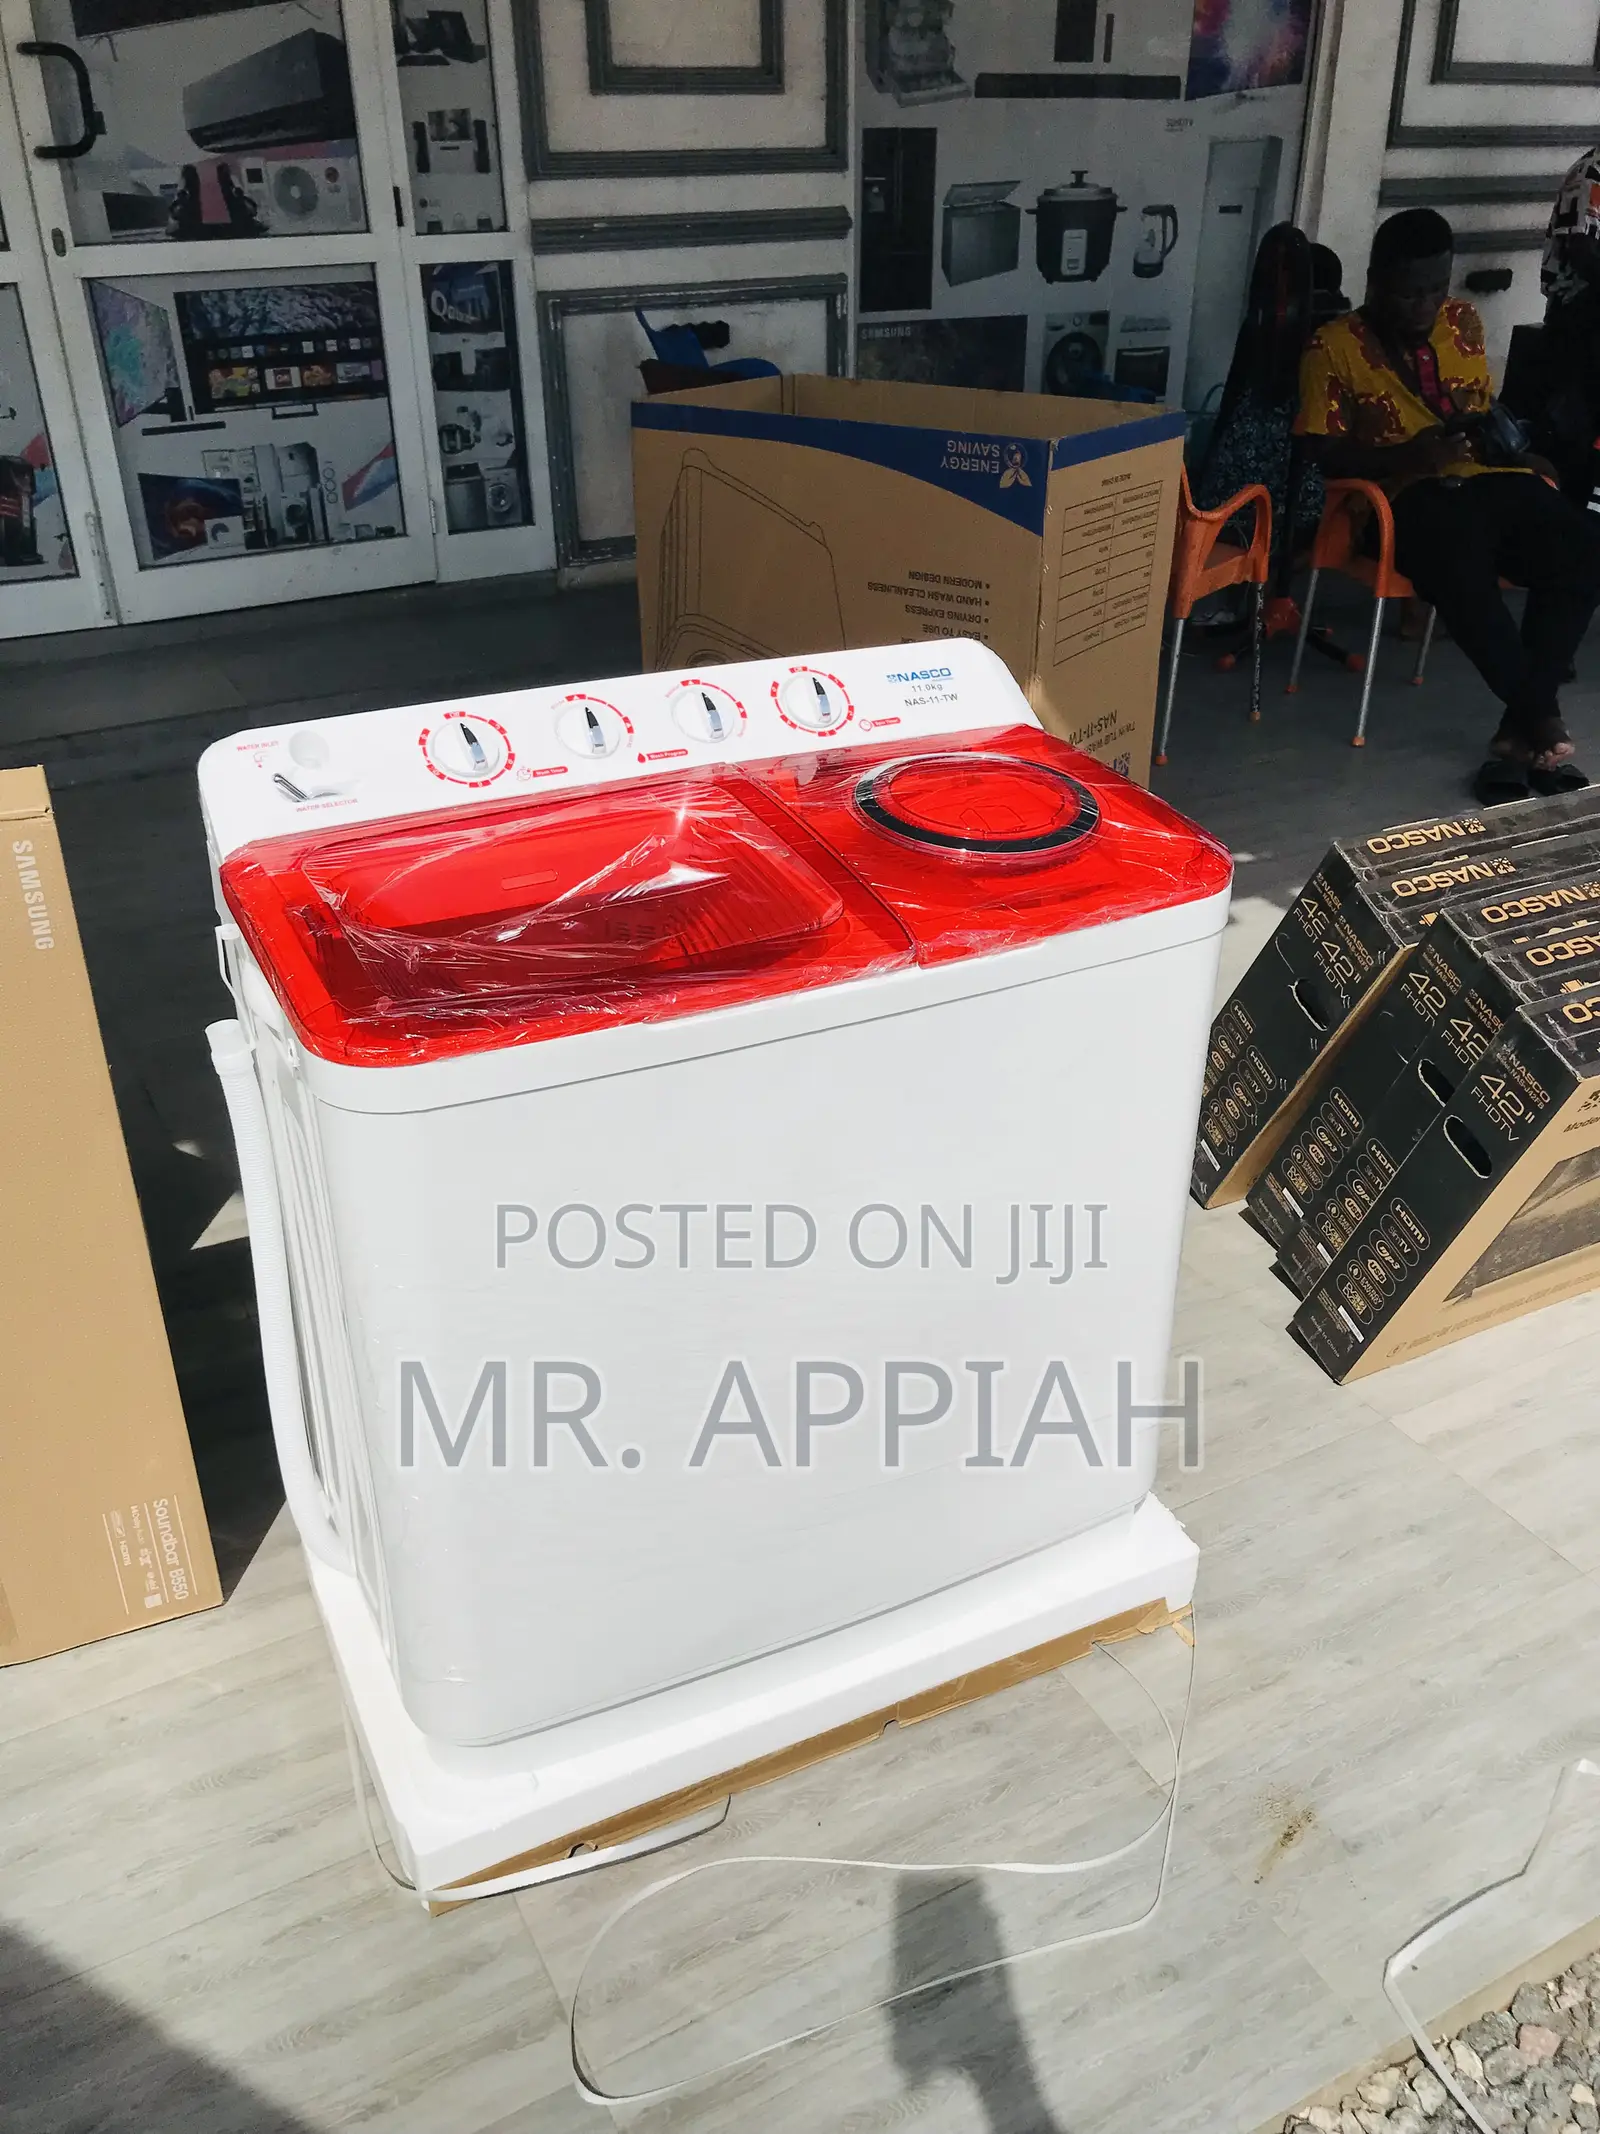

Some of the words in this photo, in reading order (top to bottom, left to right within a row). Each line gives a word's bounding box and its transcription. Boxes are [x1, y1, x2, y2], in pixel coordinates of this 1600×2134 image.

[861, 326, 911, 340] SAMSUNG
[947, 440, 1000, 457] SAVING
[940, 456, 1000, 474] ENERGY
[867, 582, 926, 598] CLEANLINESS
[908, 570, 941, 584] DESIGN
[943, 575, 983, 589] MODERN
[927, 591, 954, 602] WASH
[956, 595, 982, 607] HAND
[905, 604, 945, 618] EXPRESS
[947, 610, 981, 624] DRYING
[922, 623, 940, 634] USE
[942, 626, 954, 637] TO
[897, 667, 952, 682] NASCO
[904, 693, 958, 706] NAS-11-TW
[911, 683, 944, 693] 11.0kg
[1069, 709, 1118, 745] NAS-11-TW
[236, 743, 260, 752] WATER
[296, 804, 320, 813] WATER
[322, 798, 359, 809] SELECTOR
[1366, 821, 1467, 854] NASCO
[1391, 861, 1496, 897] NASCO
[12, 839, 55, 950] SAMSUNG
[1481, 886, 1588, 924] NASCO
[1344, 925, 1375, 967] NASCO
[1313, 951, 1351, 999] FHDTV
[1433, 952, 1464, 989] NASC
[1434, 968, 1460, 996] NAS-J42
[1408, 972, 1447, 1016] 42
[1477, 1012, 1500, 1036] NAS-J
[1450, 1018, 1490, 1061] 42
[1250, 1051, 1273, 1085] HDMI
[1508, 1053, 1551, 1104] NASCO
[1480, 1074, 1536, 1125] 42"
[1510, 1067, 1545, 1110] NAS-J42FB
[1333, 1092, 1360, 1128] HDMI
[1471, 1086, 1520, 1141] FHDTV
[1316, 1125, 1338, 1153] mp3
[1310, 1146, 1325, 1165] USB
[1346, 1199, 1362, 1220] USB
[1395, 1204, 1426, 1245] HDMI
[1375, 1239, 1401, 1271] mp3
[1368, 1260, 1386, 1284] USB
[119, 1540, 132, 1566] HDMI
[152, 1498, 180, 1566] Soundbar
[169, 1567, 189, 1600] B550
